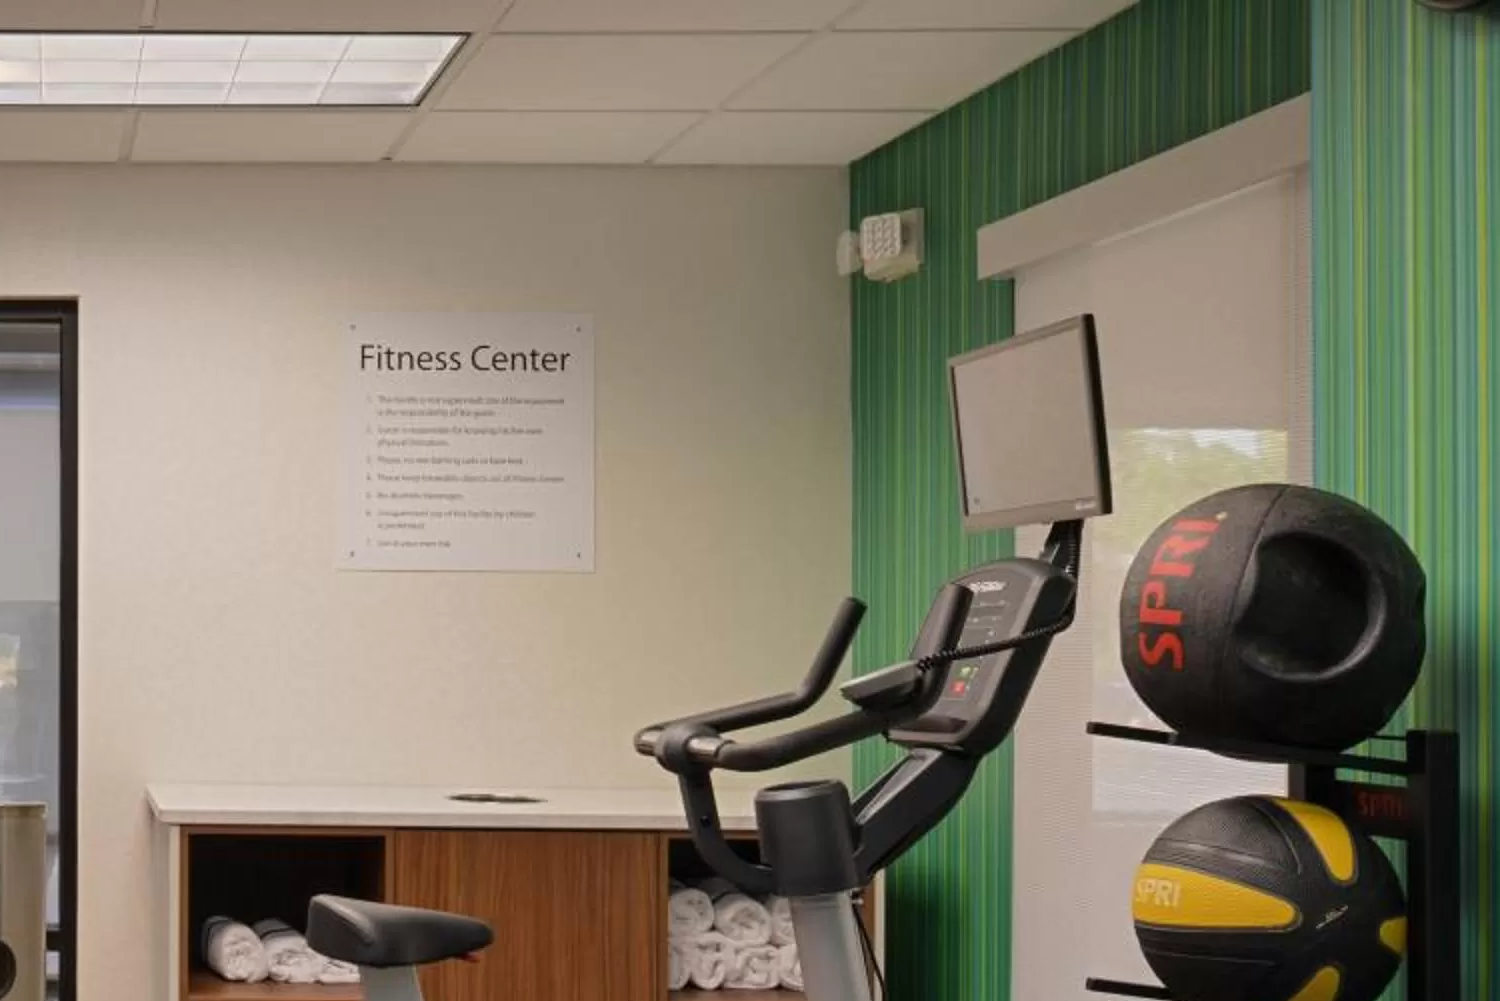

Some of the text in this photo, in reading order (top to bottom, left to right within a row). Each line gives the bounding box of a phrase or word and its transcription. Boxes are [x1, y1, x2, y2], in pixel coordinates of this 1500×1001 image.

[360, 343, 571, 372] Fitness Center
[1139, 518, 1221, 673] SPRI
[1135, 876, 1181, 909] SPRI
